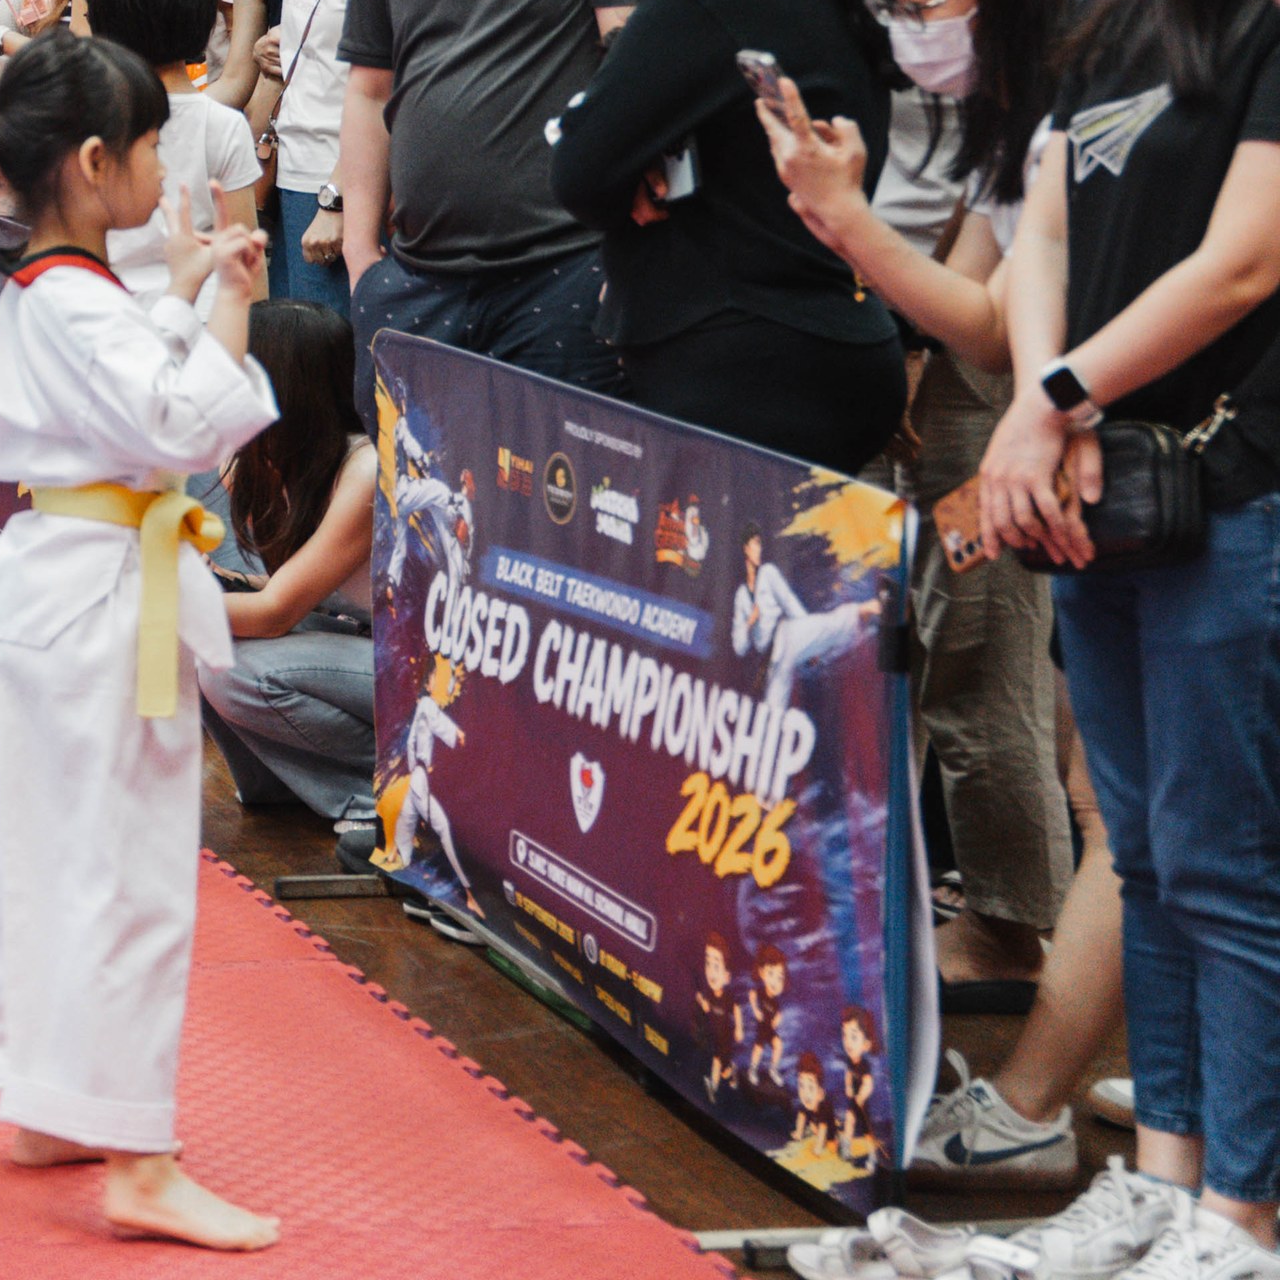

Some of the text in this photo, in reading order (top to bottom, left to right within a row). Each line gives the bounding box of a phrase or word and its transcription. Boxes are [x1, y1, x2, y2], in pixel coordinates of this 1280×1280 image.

[495, 555, 699, 646] BLACK BELT TAEKWONDO ACADEMY
[424, 570, 817, 805] CLOSED CHAMPIONSHIP
[666, 771, 797, 888] 2026
